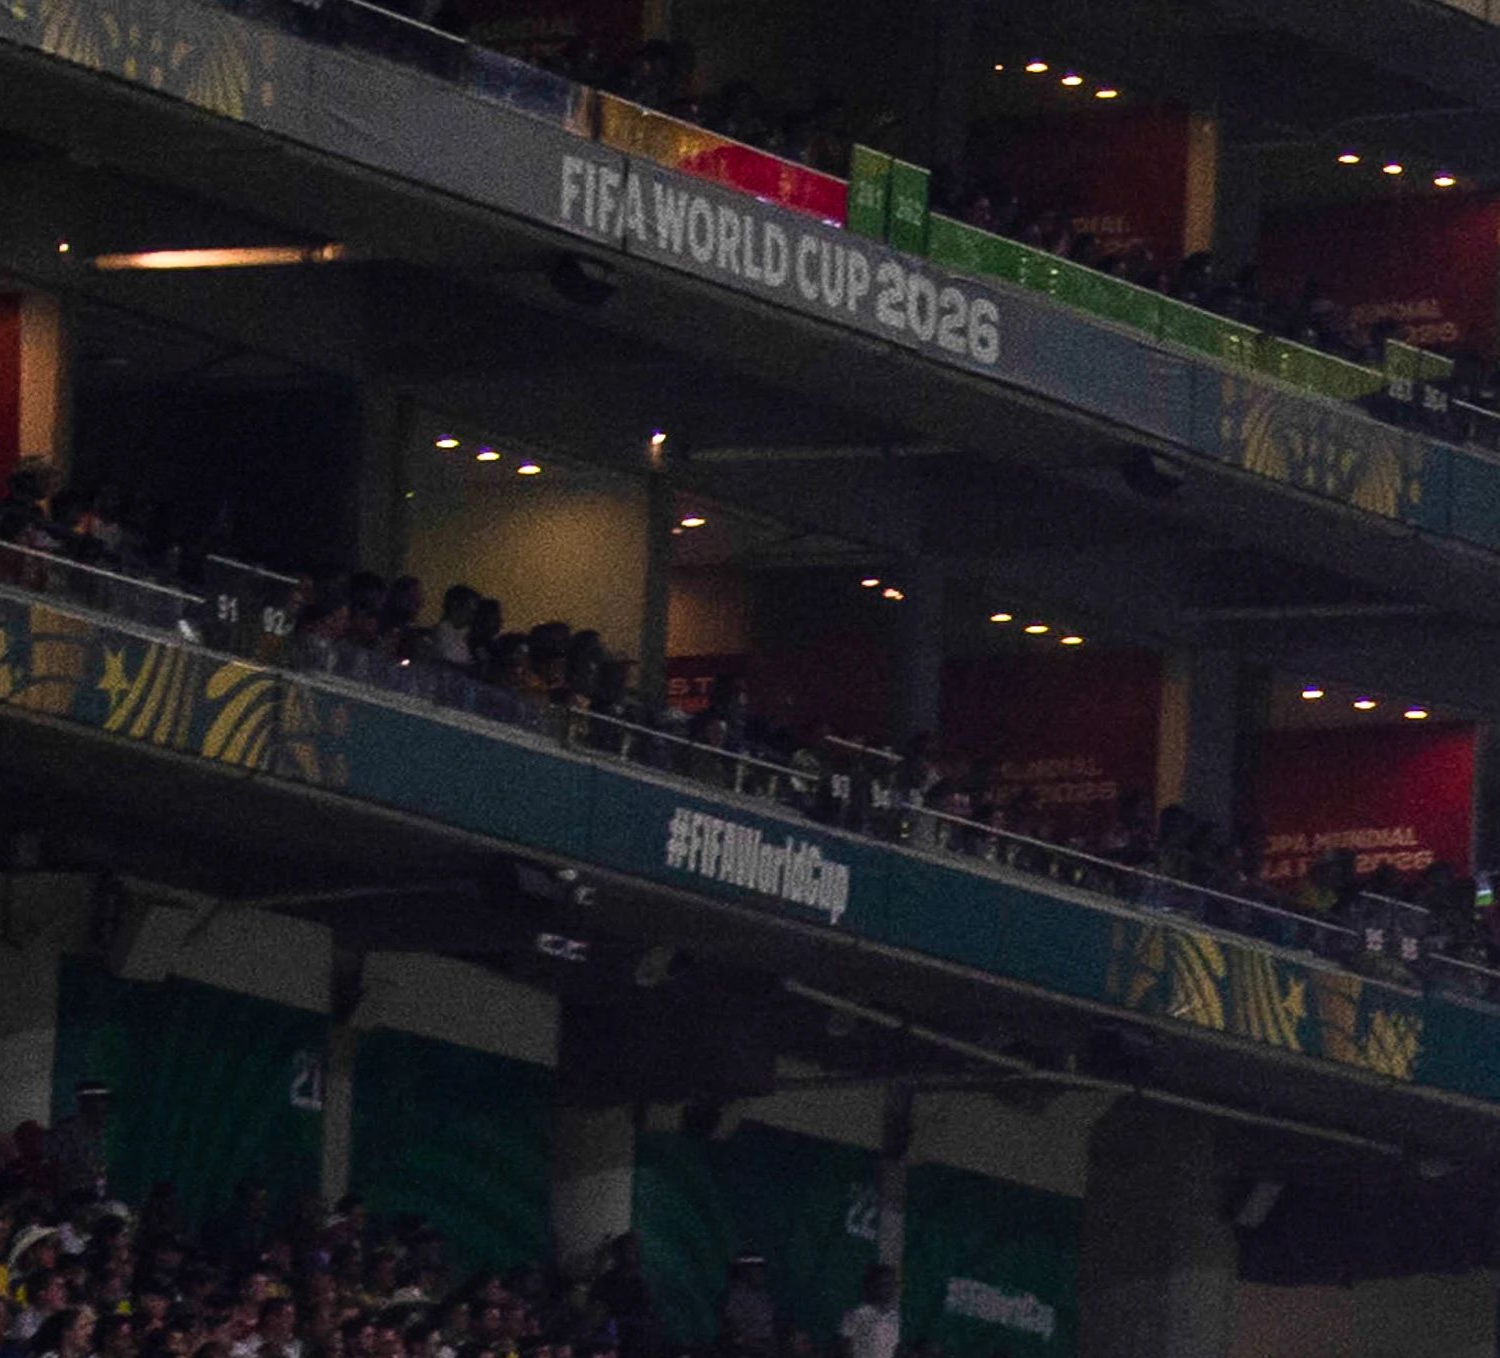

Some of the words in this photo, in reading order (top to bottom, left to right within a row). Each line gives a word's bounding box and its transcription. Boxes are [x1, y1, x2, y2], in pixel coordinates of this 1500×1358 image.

[559, 155, 645, 244] FIFA
[653, 180, 786, 289] WORLD
[796, 236, 869, 313] CUP
[876, 261, 1000, 366] 2026
[666, 806, 852, 925] #FIFAWorldCup
